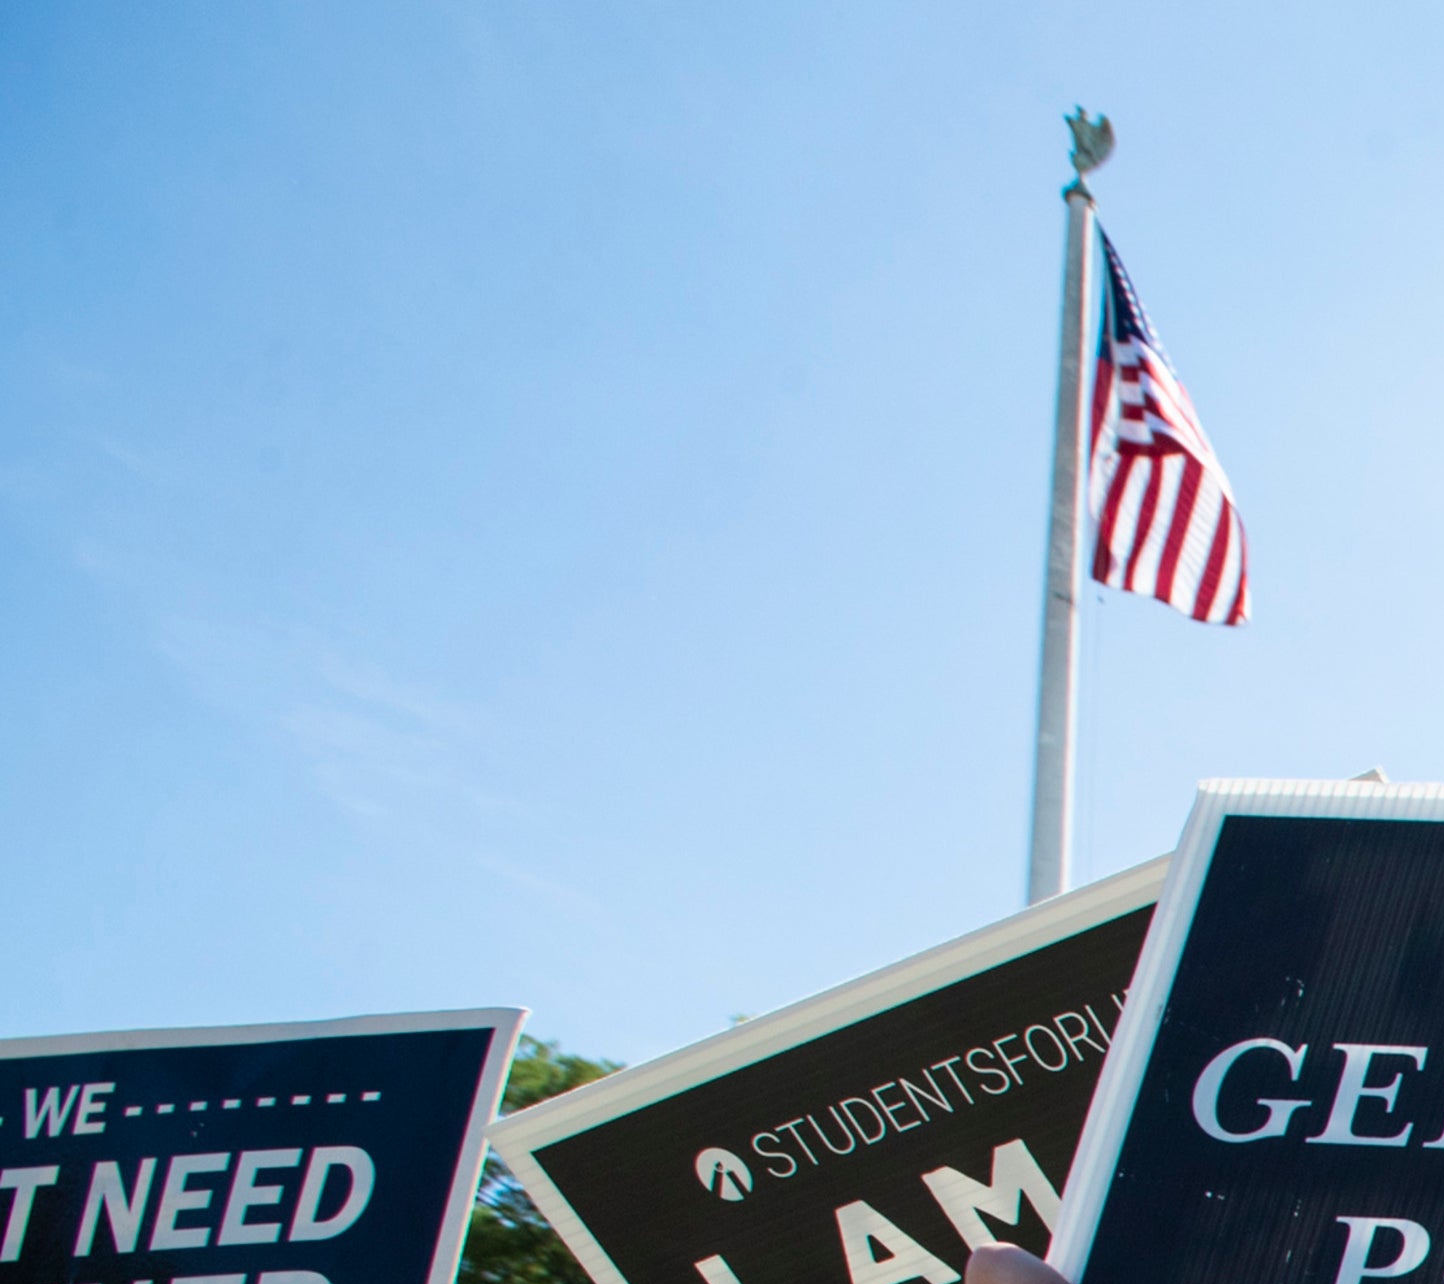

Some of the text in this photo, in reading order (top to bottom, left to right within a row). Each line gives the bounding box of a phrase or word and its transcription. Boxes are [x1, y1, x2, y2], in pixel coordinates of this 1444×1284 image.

[24, 1083, 116, 1139] WE
[751, 989, 1129, 1178] STUDENTSFORL
[74, 1145, 377, 1258] NEED
